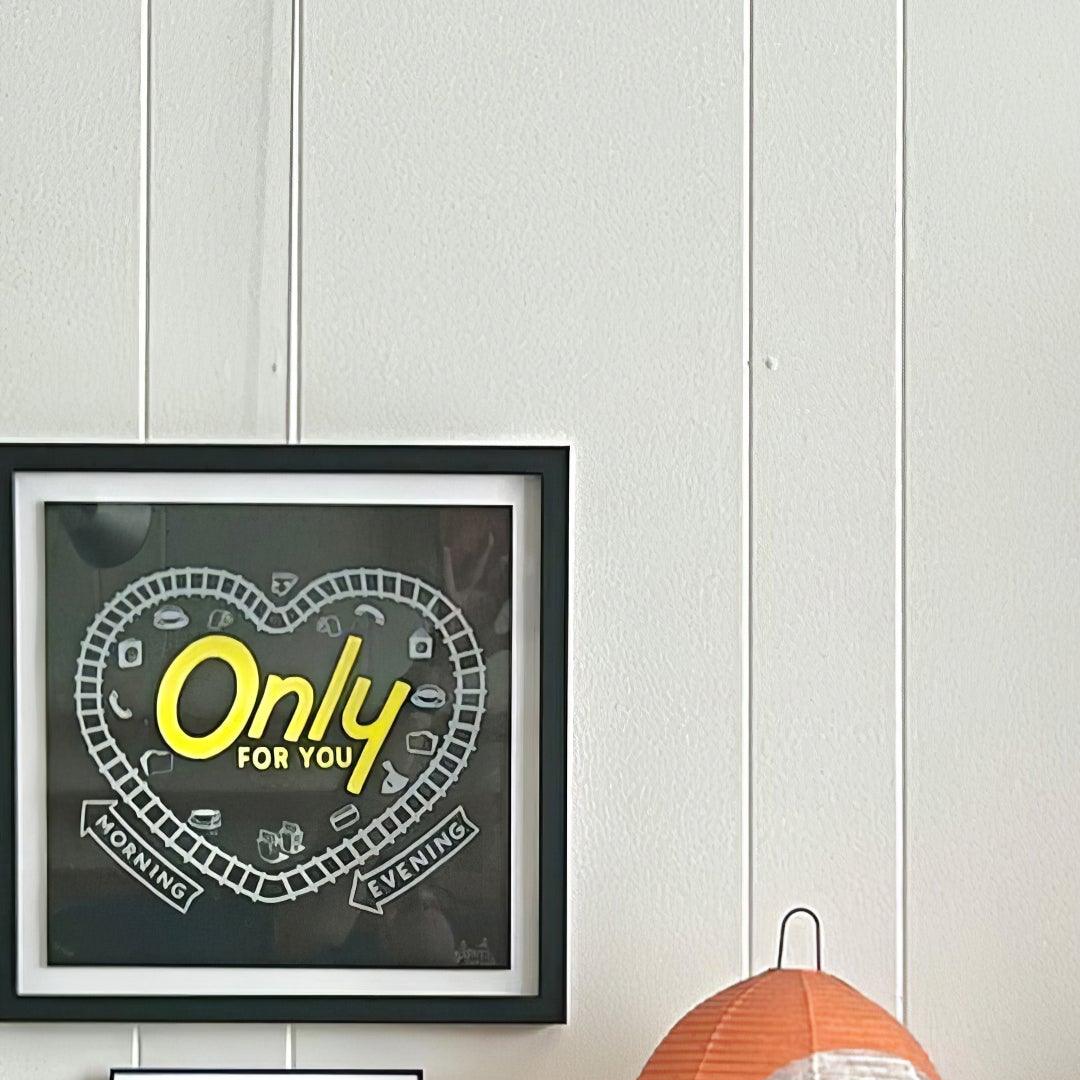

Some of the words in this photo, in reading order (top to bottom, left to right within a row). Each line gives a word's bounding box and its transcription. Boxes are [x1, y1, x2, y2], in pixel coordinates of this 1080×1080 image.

[156, 634, 411, 794] Only
[238, 746, 289, 769] FOR
[299, 746, 352, 769] YOU
[95, 814, 187, 899] MORNING
[367, 821, 466, 899] EVENING
